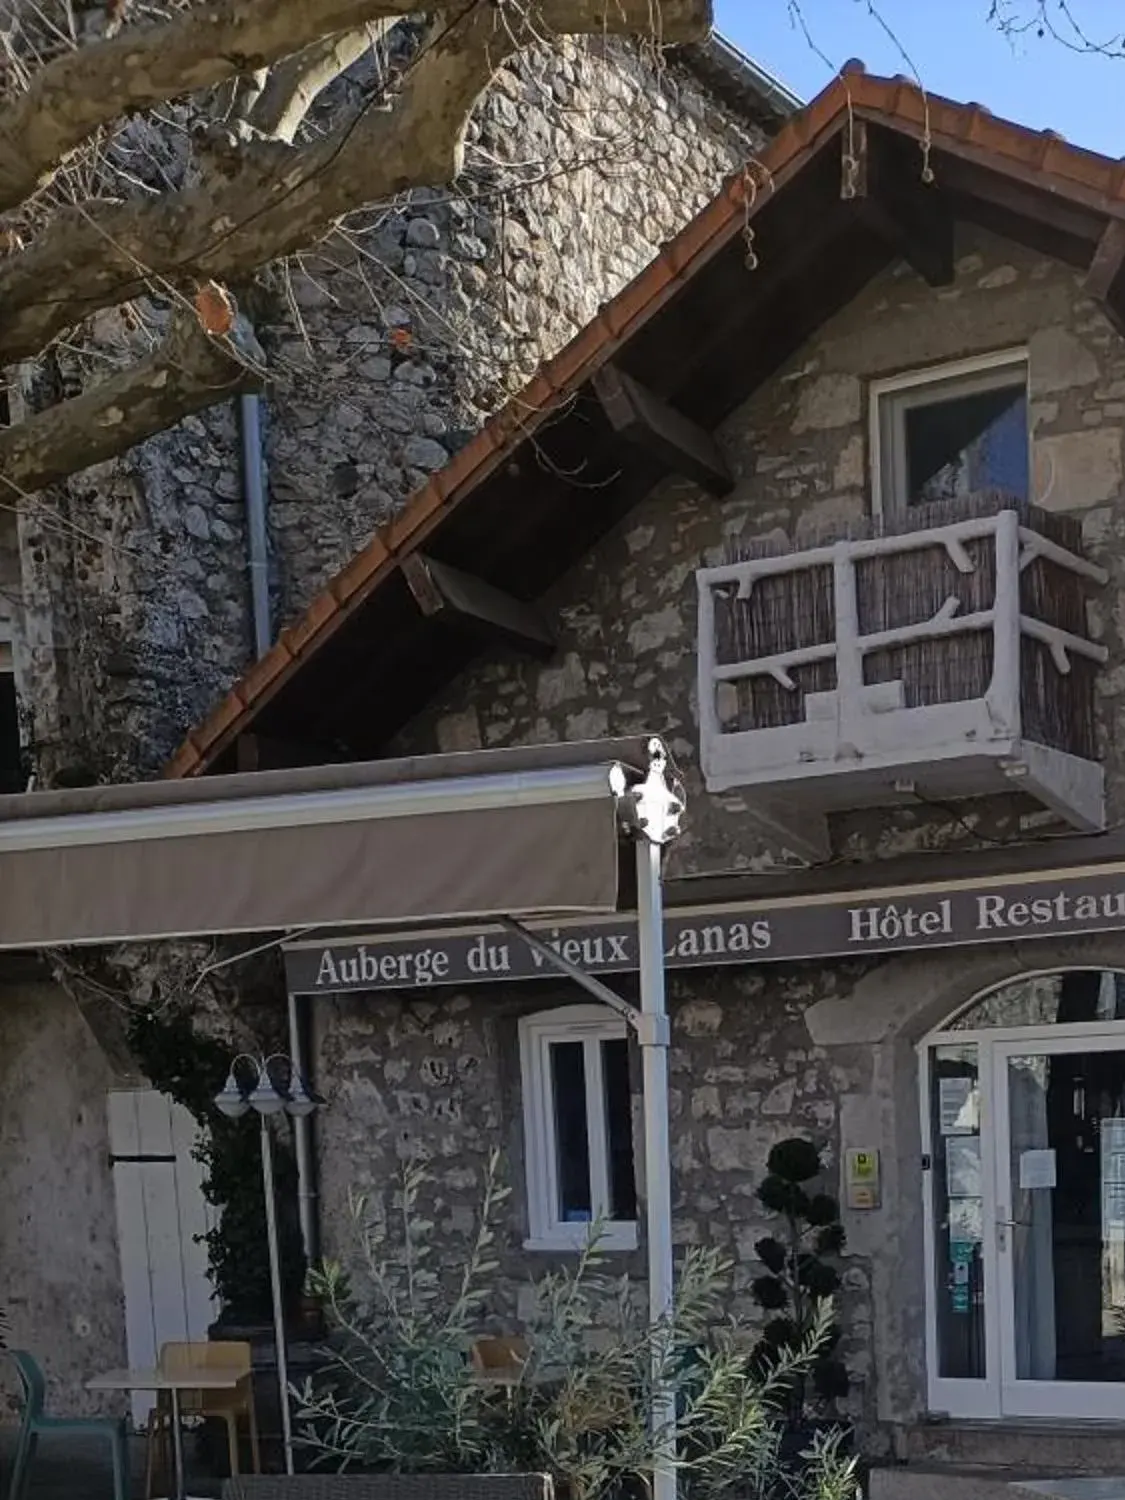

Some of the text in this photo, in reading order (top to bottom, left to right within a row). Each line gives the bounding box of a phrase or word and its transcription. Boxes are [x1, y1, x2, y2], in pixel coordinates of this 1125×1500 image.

[847, 899, 953, 942] Hôtel
[315, 945, 450, 986] Auberge
[466, 935, 511, 973] du
[664, 919, 772, 958] anas
